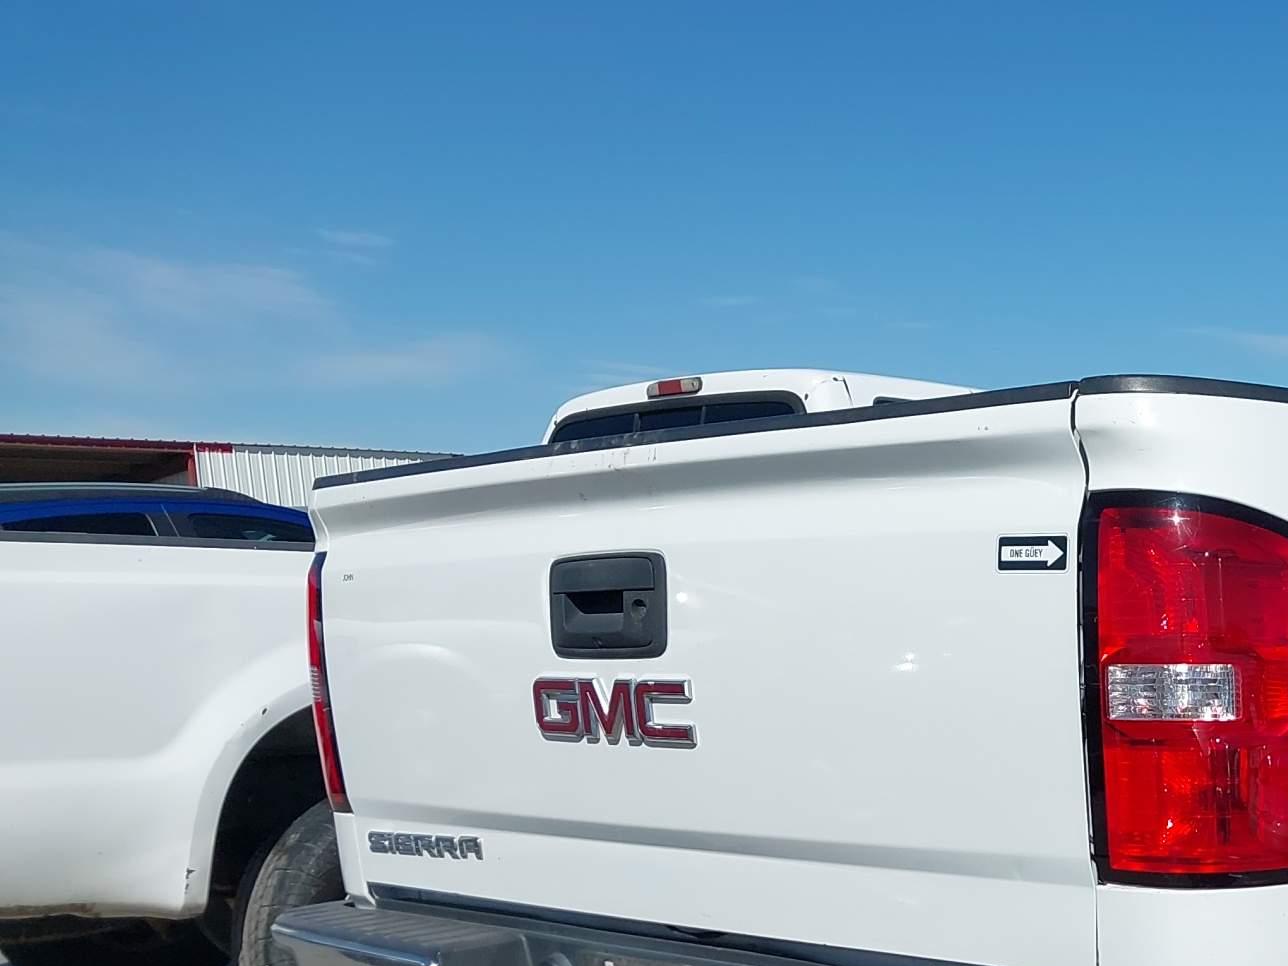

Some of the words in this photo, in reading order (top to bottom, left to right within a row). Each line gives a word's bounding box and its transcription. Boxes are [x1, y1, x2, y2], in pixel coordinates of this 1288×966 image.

[1009, 548, 1023, 558] ONE
[533, 678, 698, 749] GMC
[368, 831, 484, 860] SIERRA
